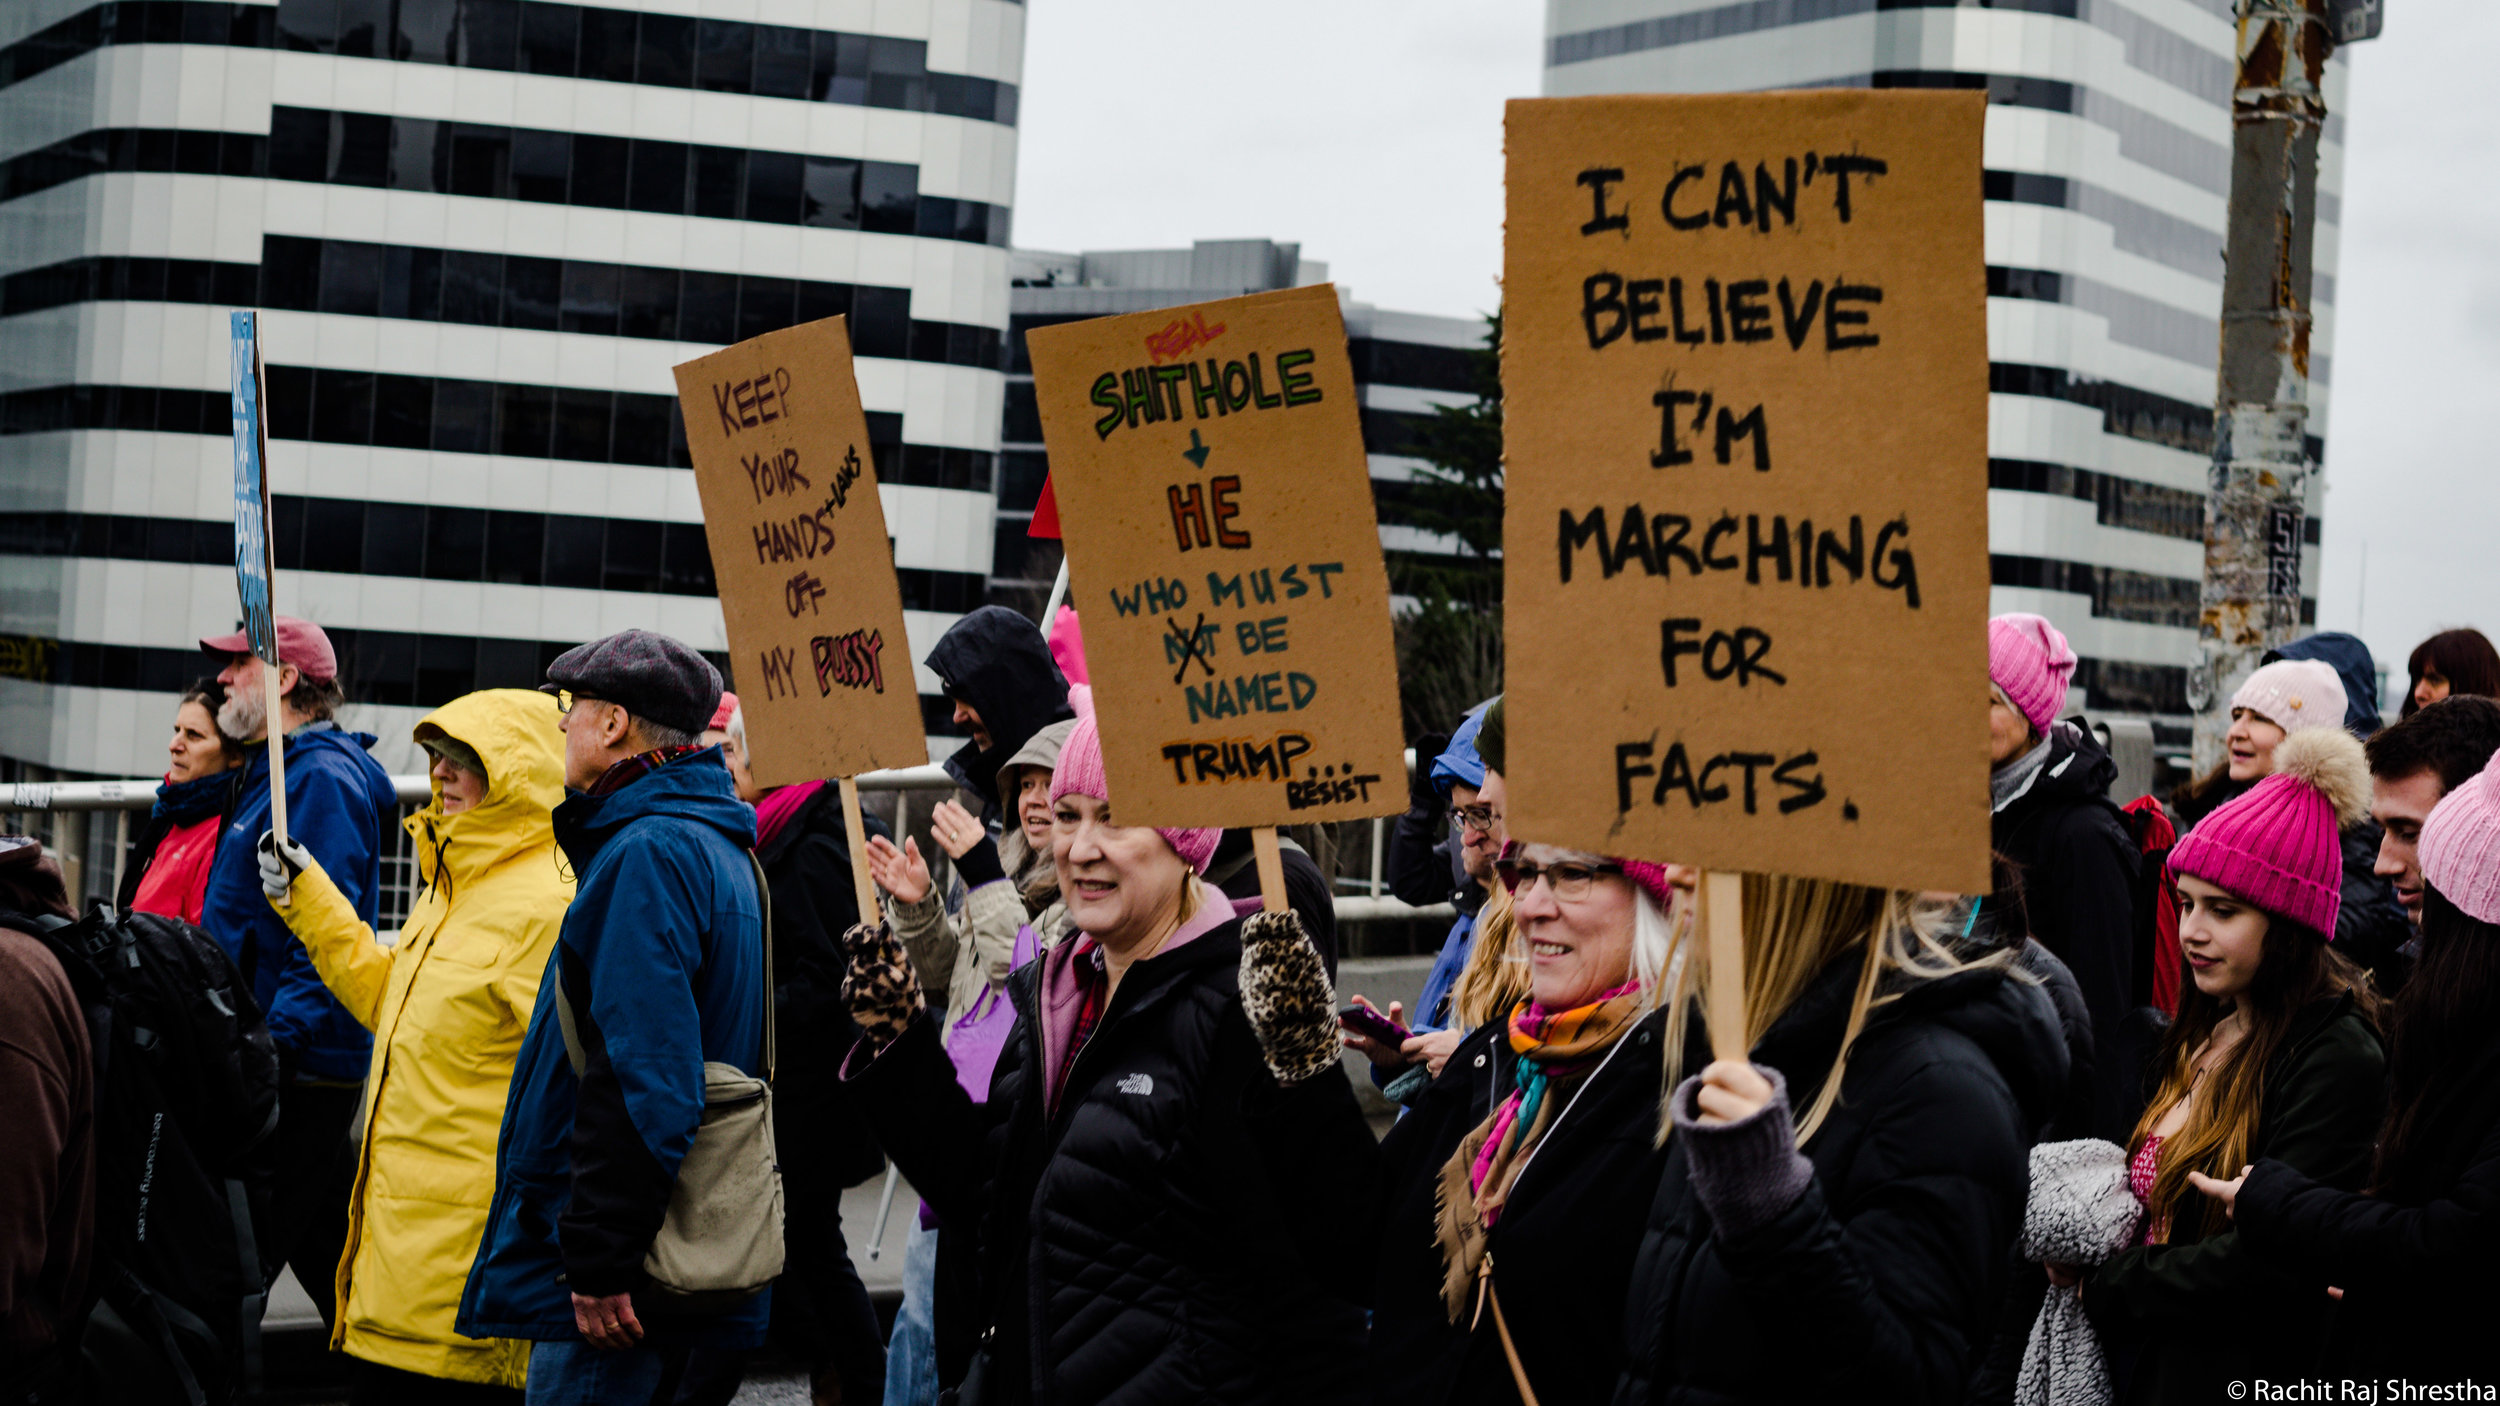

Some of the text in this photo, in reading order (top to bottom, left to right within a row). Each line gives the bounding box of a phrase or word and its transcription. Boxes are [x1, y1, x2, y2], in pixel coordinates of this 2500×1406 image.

[1576, 150, 1888, 236] I CAN'T
[1145, 310, 1226, 365] REAL
[1584, 271, 1883, 351] BELIEVE
[713, 366, 791, 437] KEEP
[1091, 348, 1323, 441] SHITHOLE
[1650, 389, 1771, 472] I'M
[741, 447, 811, 505] YOUR
[752, 507, 836, 565] HANDS
[1167, 475, 1251, 552] HE
[1110, 562, 1344, 618] WHO MUST
[1558, 503, 1921, 609] MARCHING
[785, 570, 827, 618] OFF
[761, 627, 884, 701] MY PUSSY
[1236, 616, 1288, 656] BE
[1661, 618, 1786, 687] FOR
[1184, 671, 1317, 724] NAMED
[1286, 774, 1380, 811] RESIST
[1614, 740, 1861, 824] FACTS.
[137, 1196, 149, 1242] access
